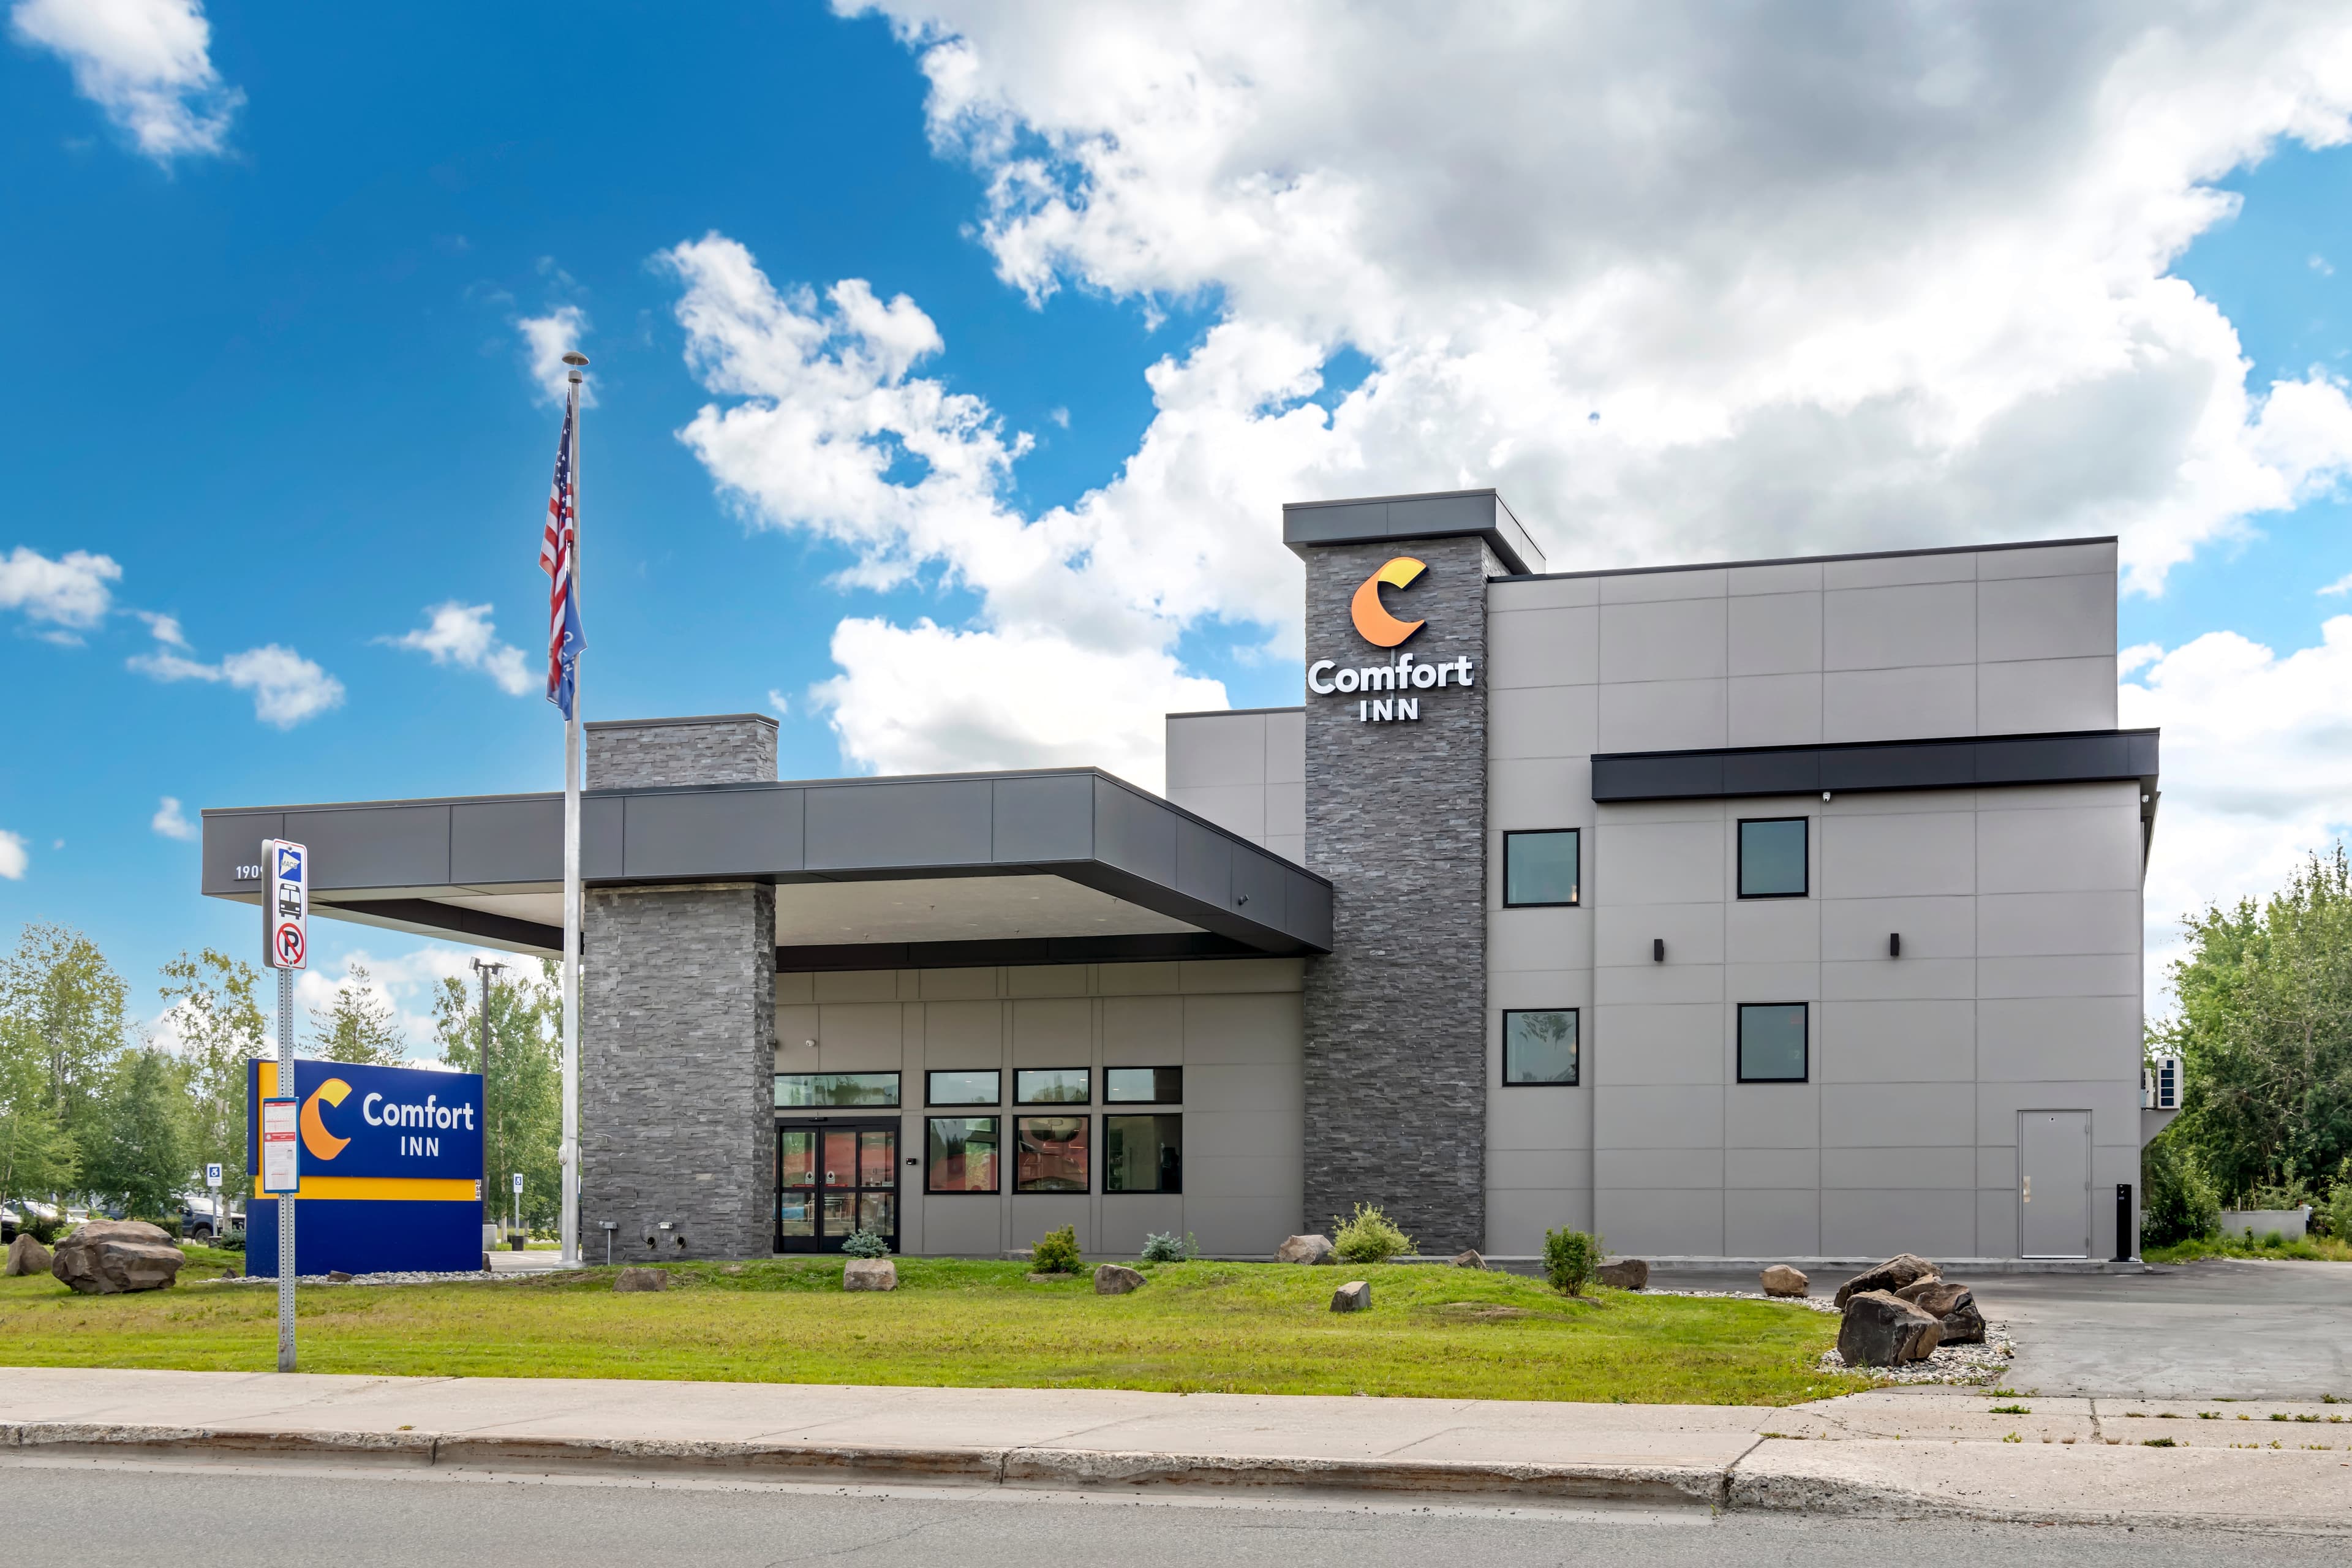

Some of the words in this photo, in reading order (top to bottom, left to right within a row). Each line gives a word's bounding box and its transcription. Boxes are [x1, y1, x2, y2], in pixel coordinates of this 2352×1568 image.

[1308, 653, 1473, 695] Comfort
[1360, 698, 1419, 722] INN
[363, 1092, 474, 1131] Comfort
[401, 1136, 439, 1157] INN
